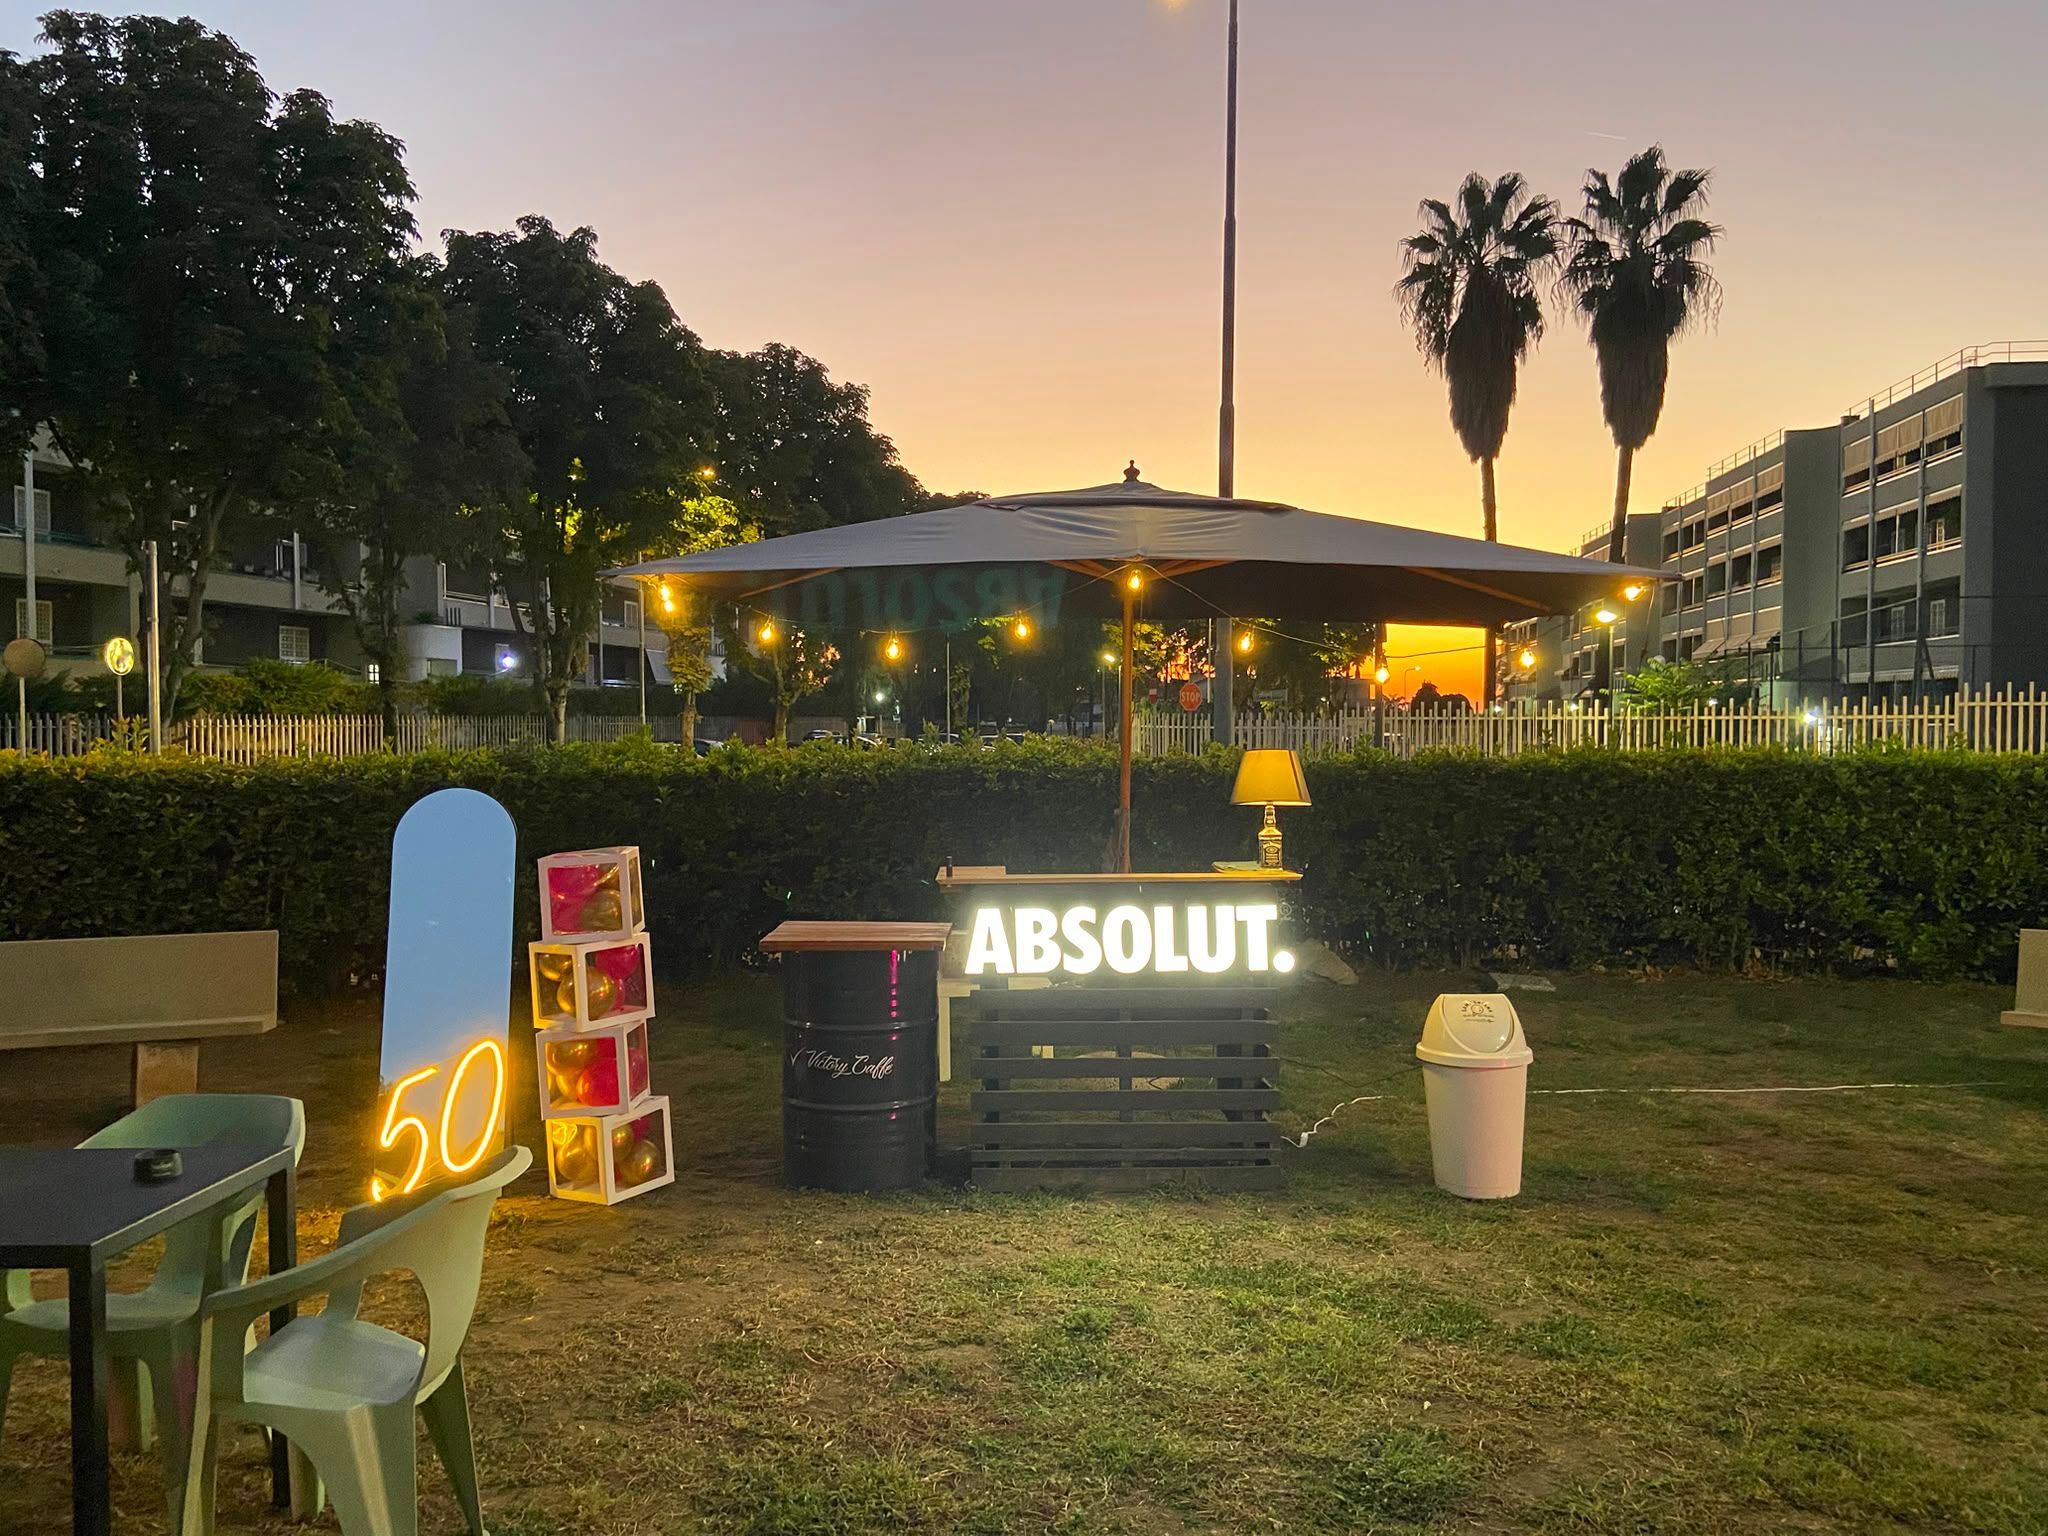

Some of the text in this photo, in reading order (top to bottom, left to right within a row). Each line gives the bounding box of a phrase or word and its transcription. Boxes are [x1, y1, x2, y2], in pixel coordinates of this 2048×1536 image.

[1181, 691, 1201, 703] STOP
[965, 905, 1295, 974] ABSOLUT.
[806, 1050, 852, 1079] Victory
[371, 1040, 503, 1202] 50
